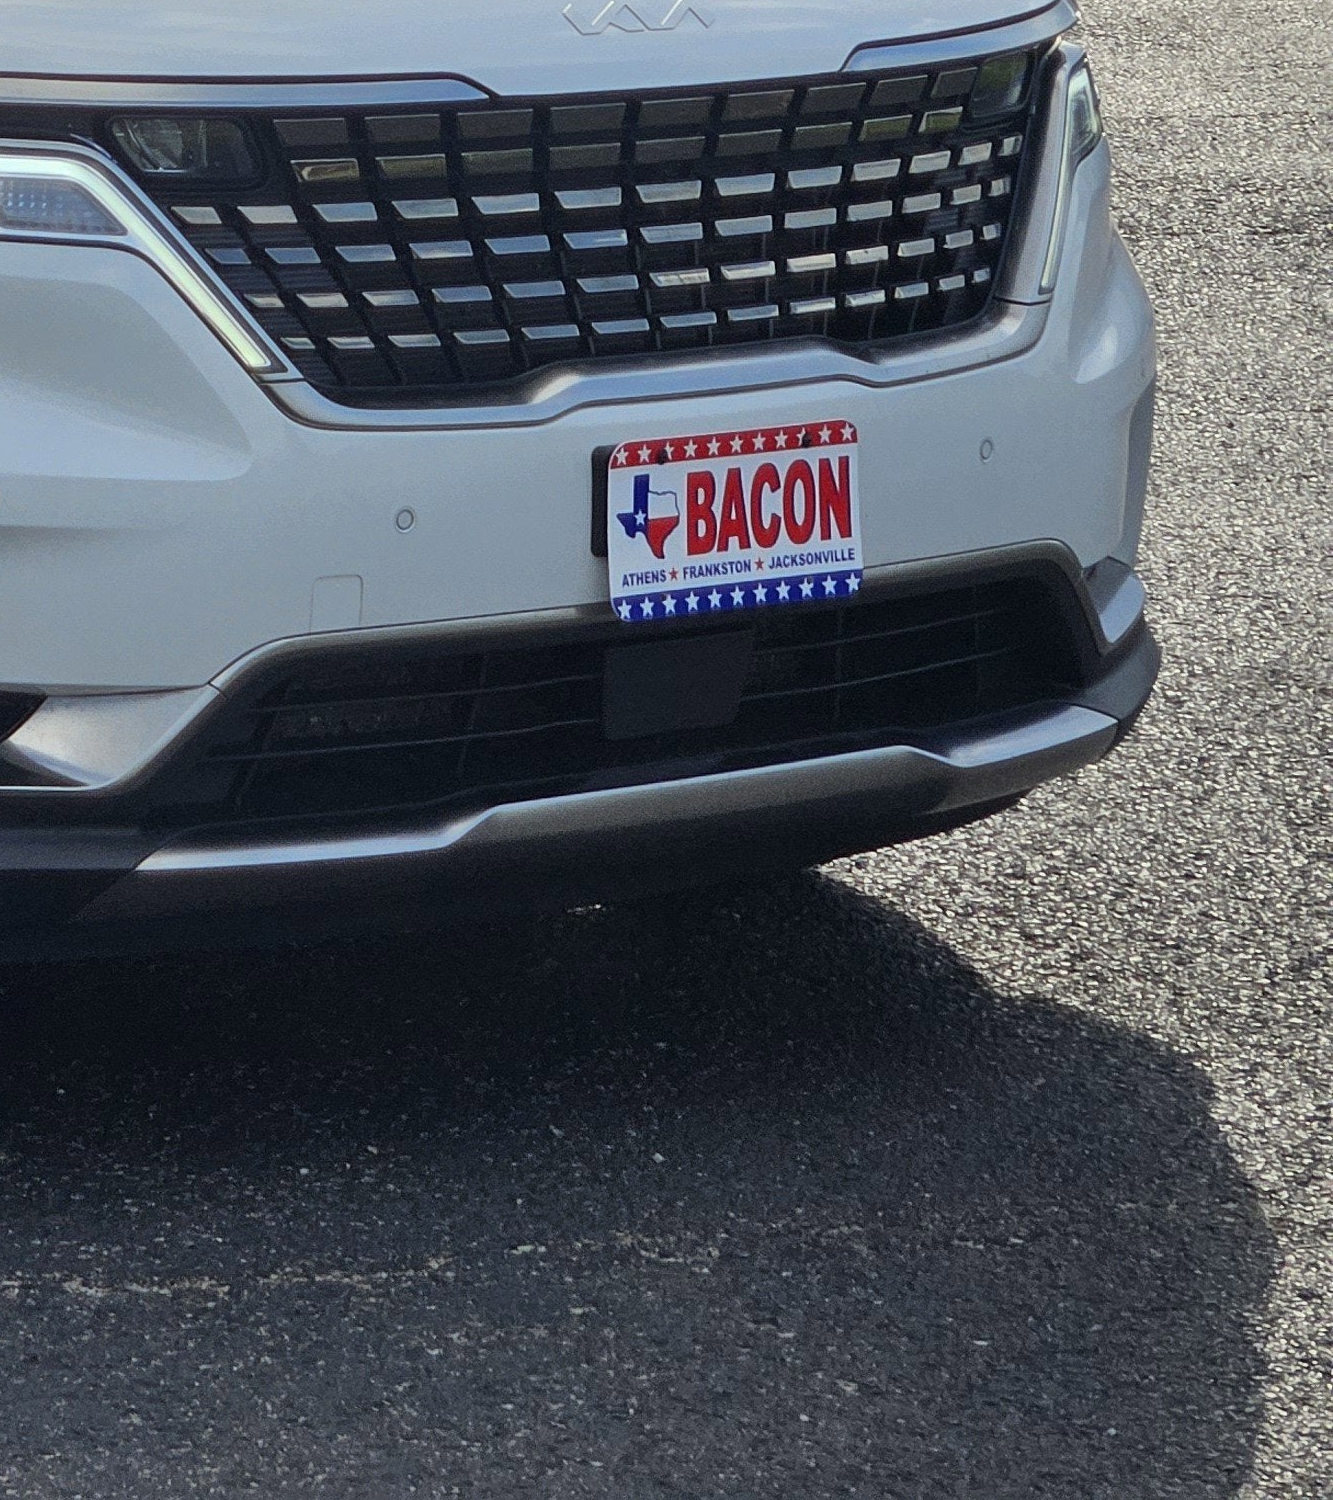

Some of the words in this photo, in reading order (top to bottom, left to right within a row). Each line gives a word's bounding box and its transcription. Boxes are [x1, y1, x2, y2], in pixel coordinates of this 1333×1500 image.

[686, 455, 852, 556] BACON
[621, 569, 667, 588] ATHENS
[683, 559, 752, 580] FRANKSTON
[768, 548, 856, 569] JACKSONVILLE
